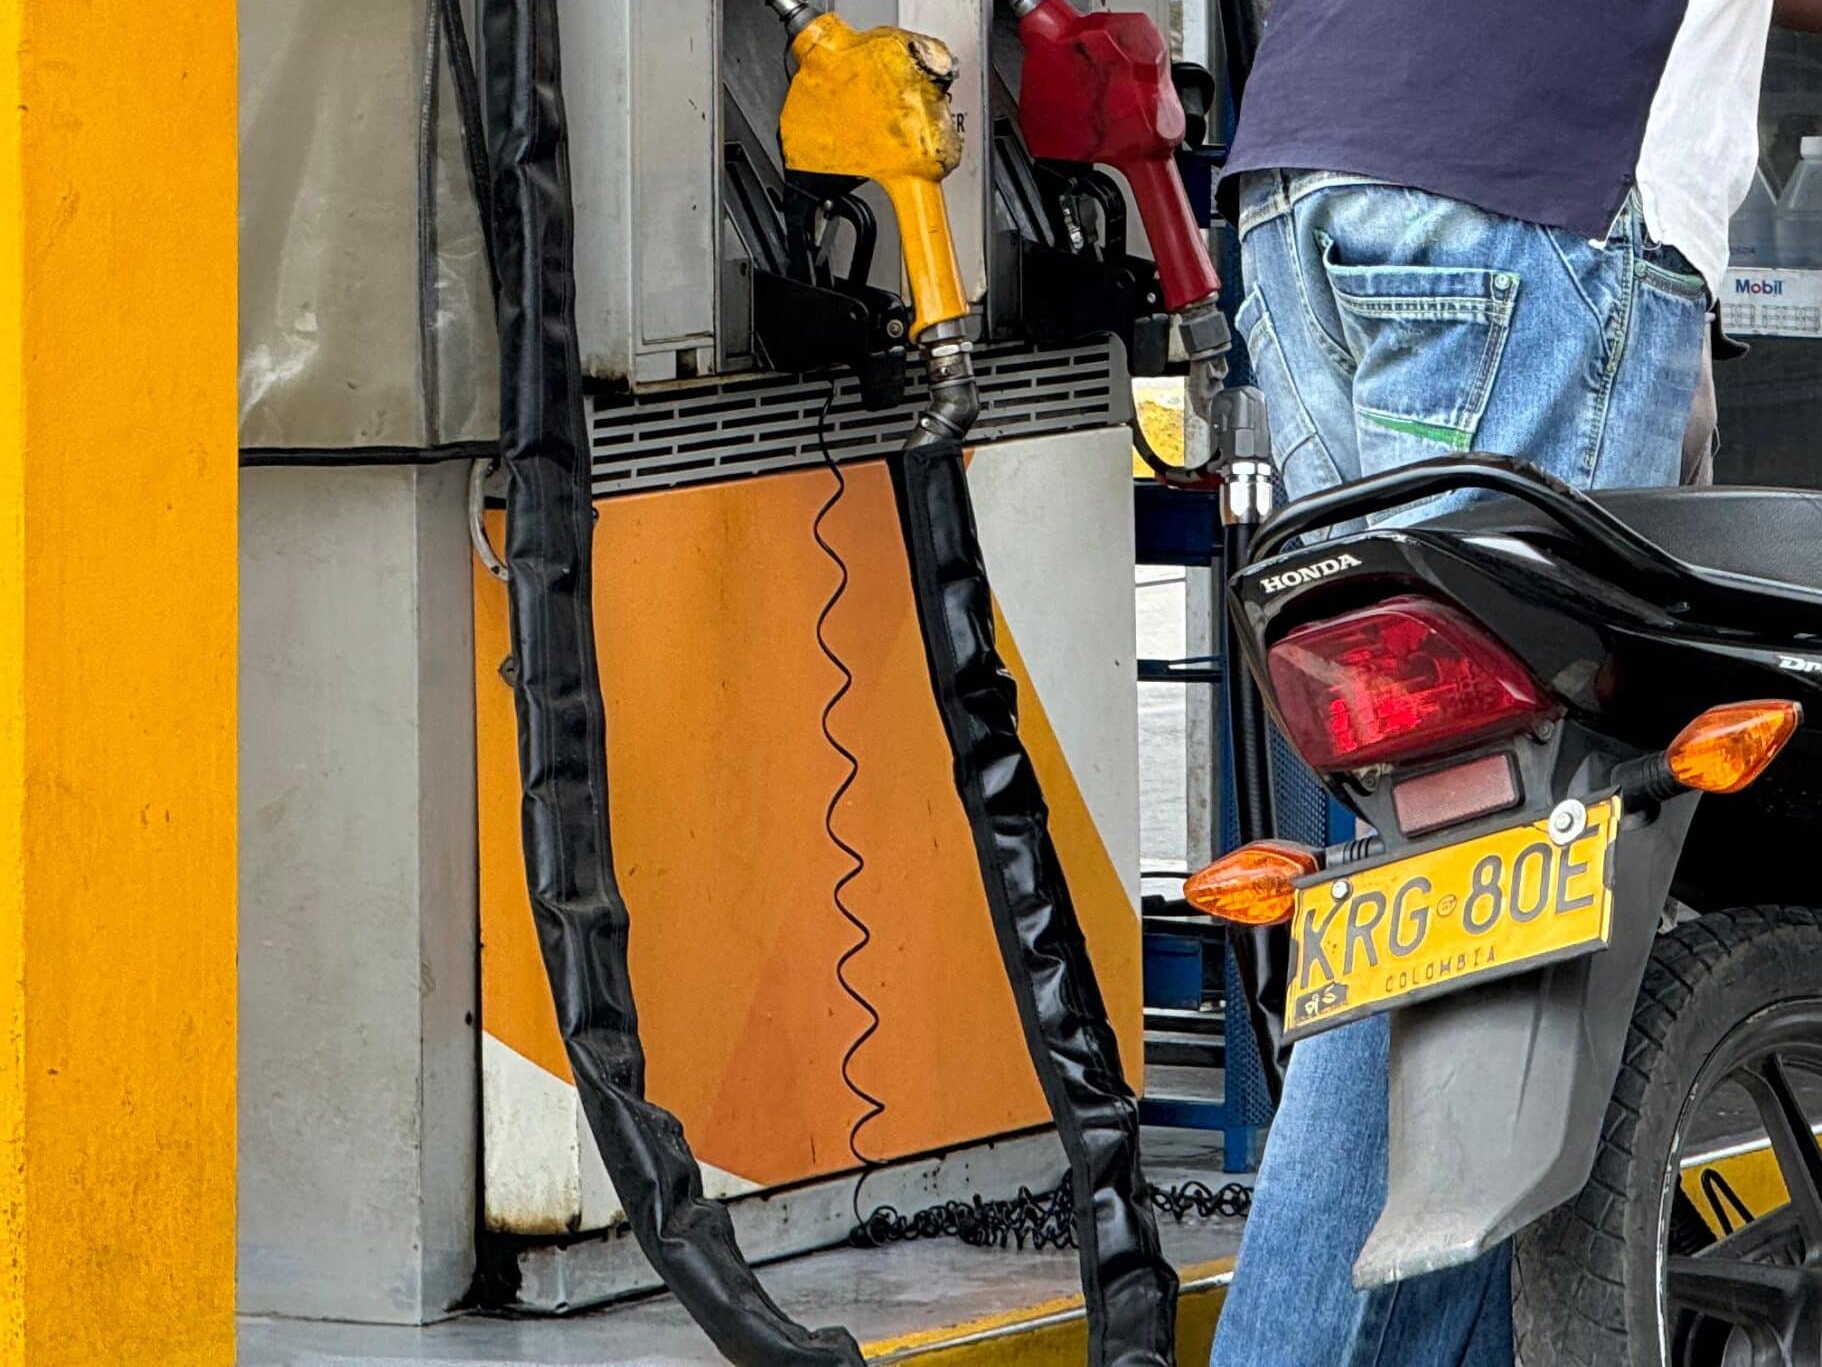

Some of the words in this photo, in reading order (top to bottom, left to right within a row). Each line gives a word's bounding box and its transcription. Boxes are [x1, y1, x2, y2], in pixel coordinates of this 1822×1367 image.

[1735, 278, 1783, 295] Mobil
[1260, 553, 1363, 594] HONDA
[1300, 876, 1432, 989] KRG
[1462, 823, 1600, 935] 80E
[1386, 945, 1496, 993] COLOMBIA
